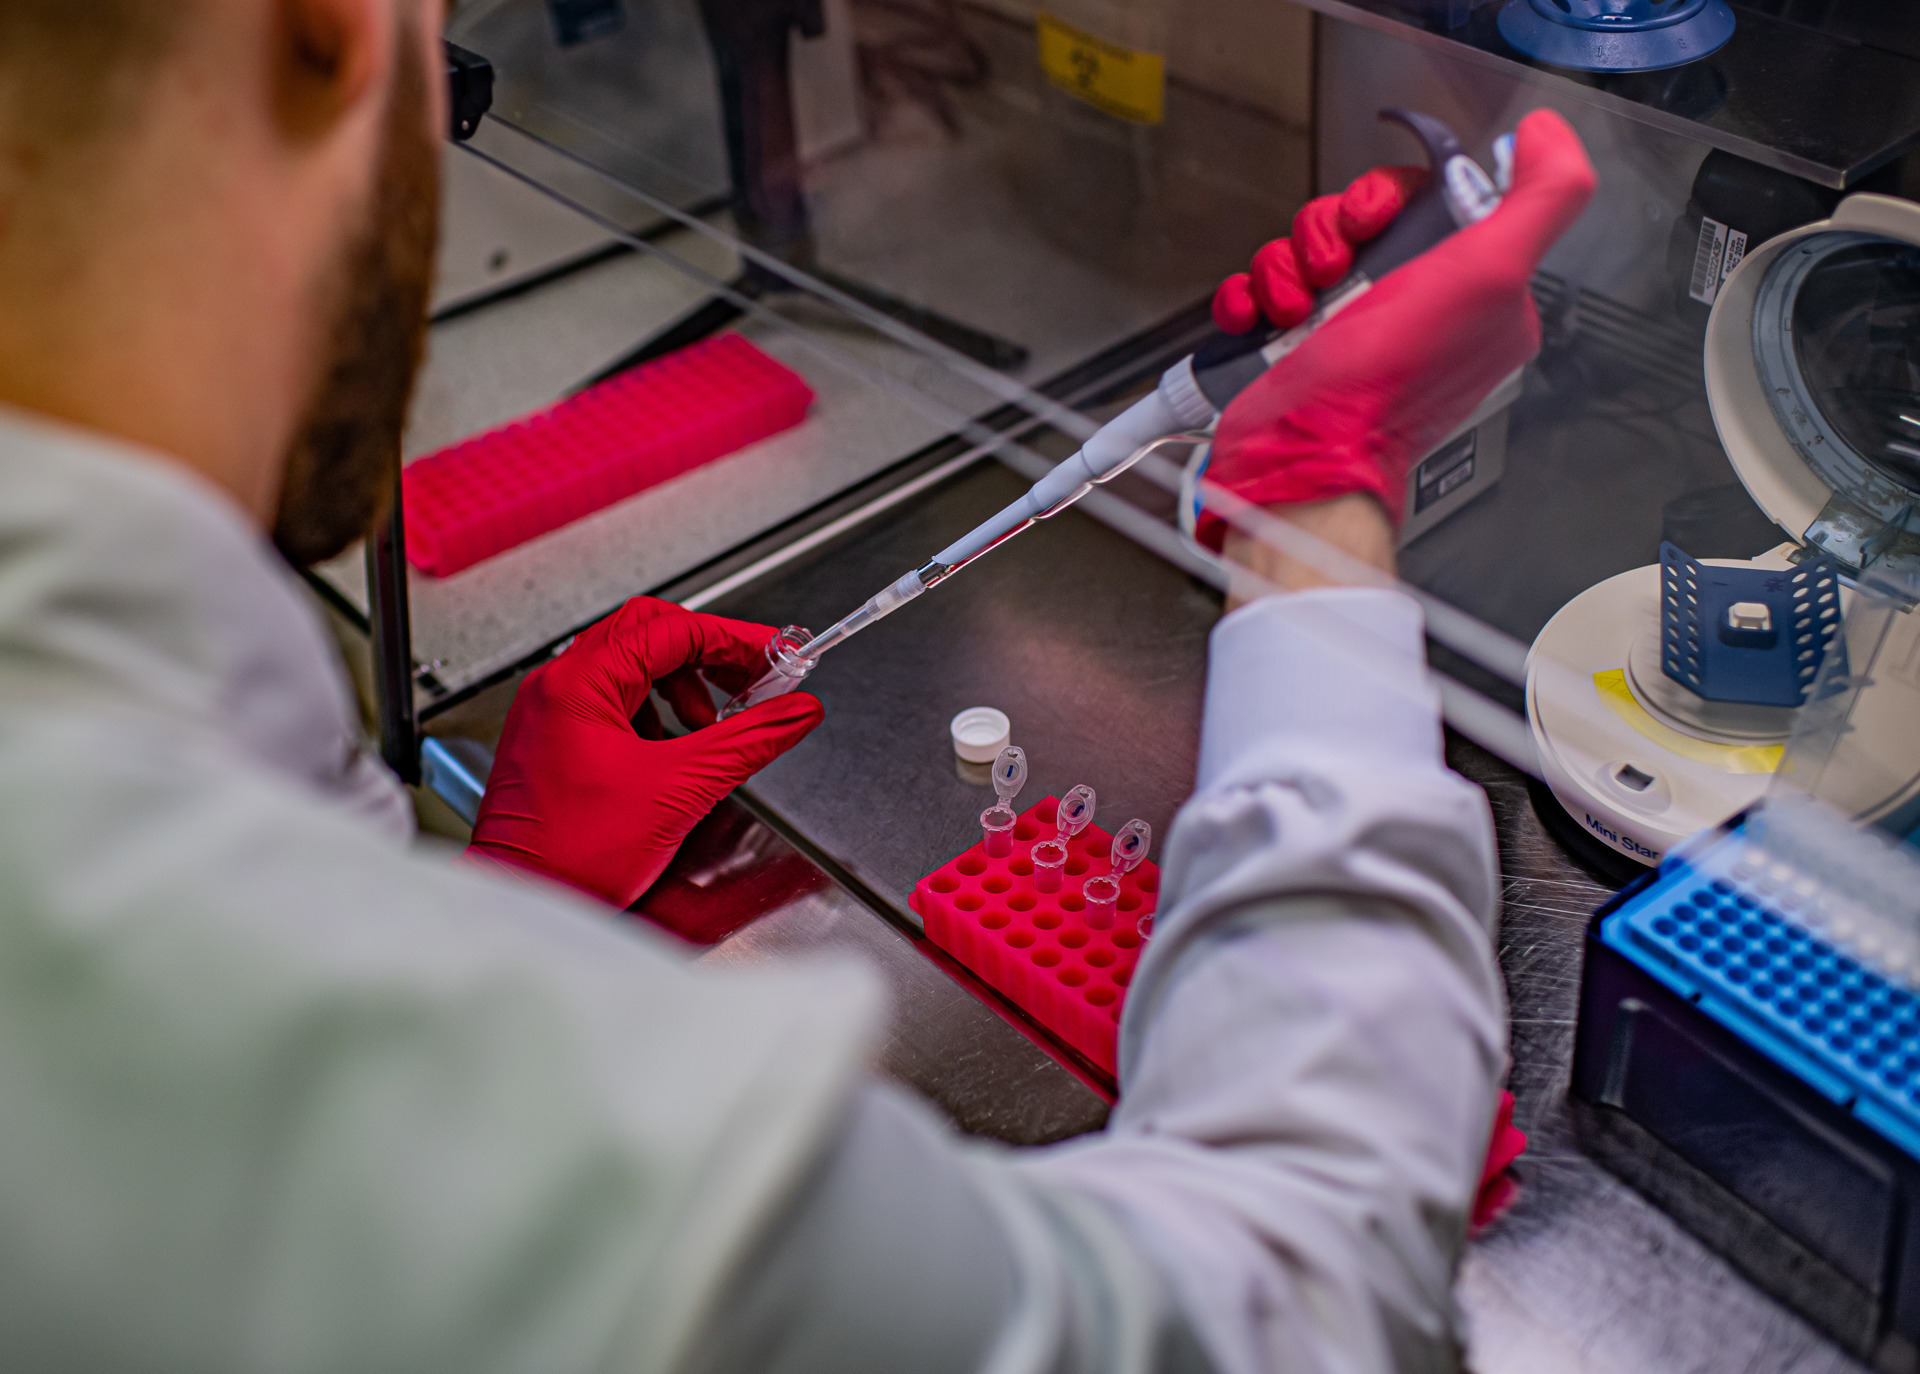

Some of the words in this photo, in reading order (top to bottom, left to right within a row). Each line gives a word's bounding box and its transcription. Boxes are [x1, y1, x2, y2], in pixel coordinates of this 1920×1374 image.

[1734, 237, 1745, 256] 2022
[1585, 813, 1618, 843] Mini
[1621, 836, 1659, 860] Star
